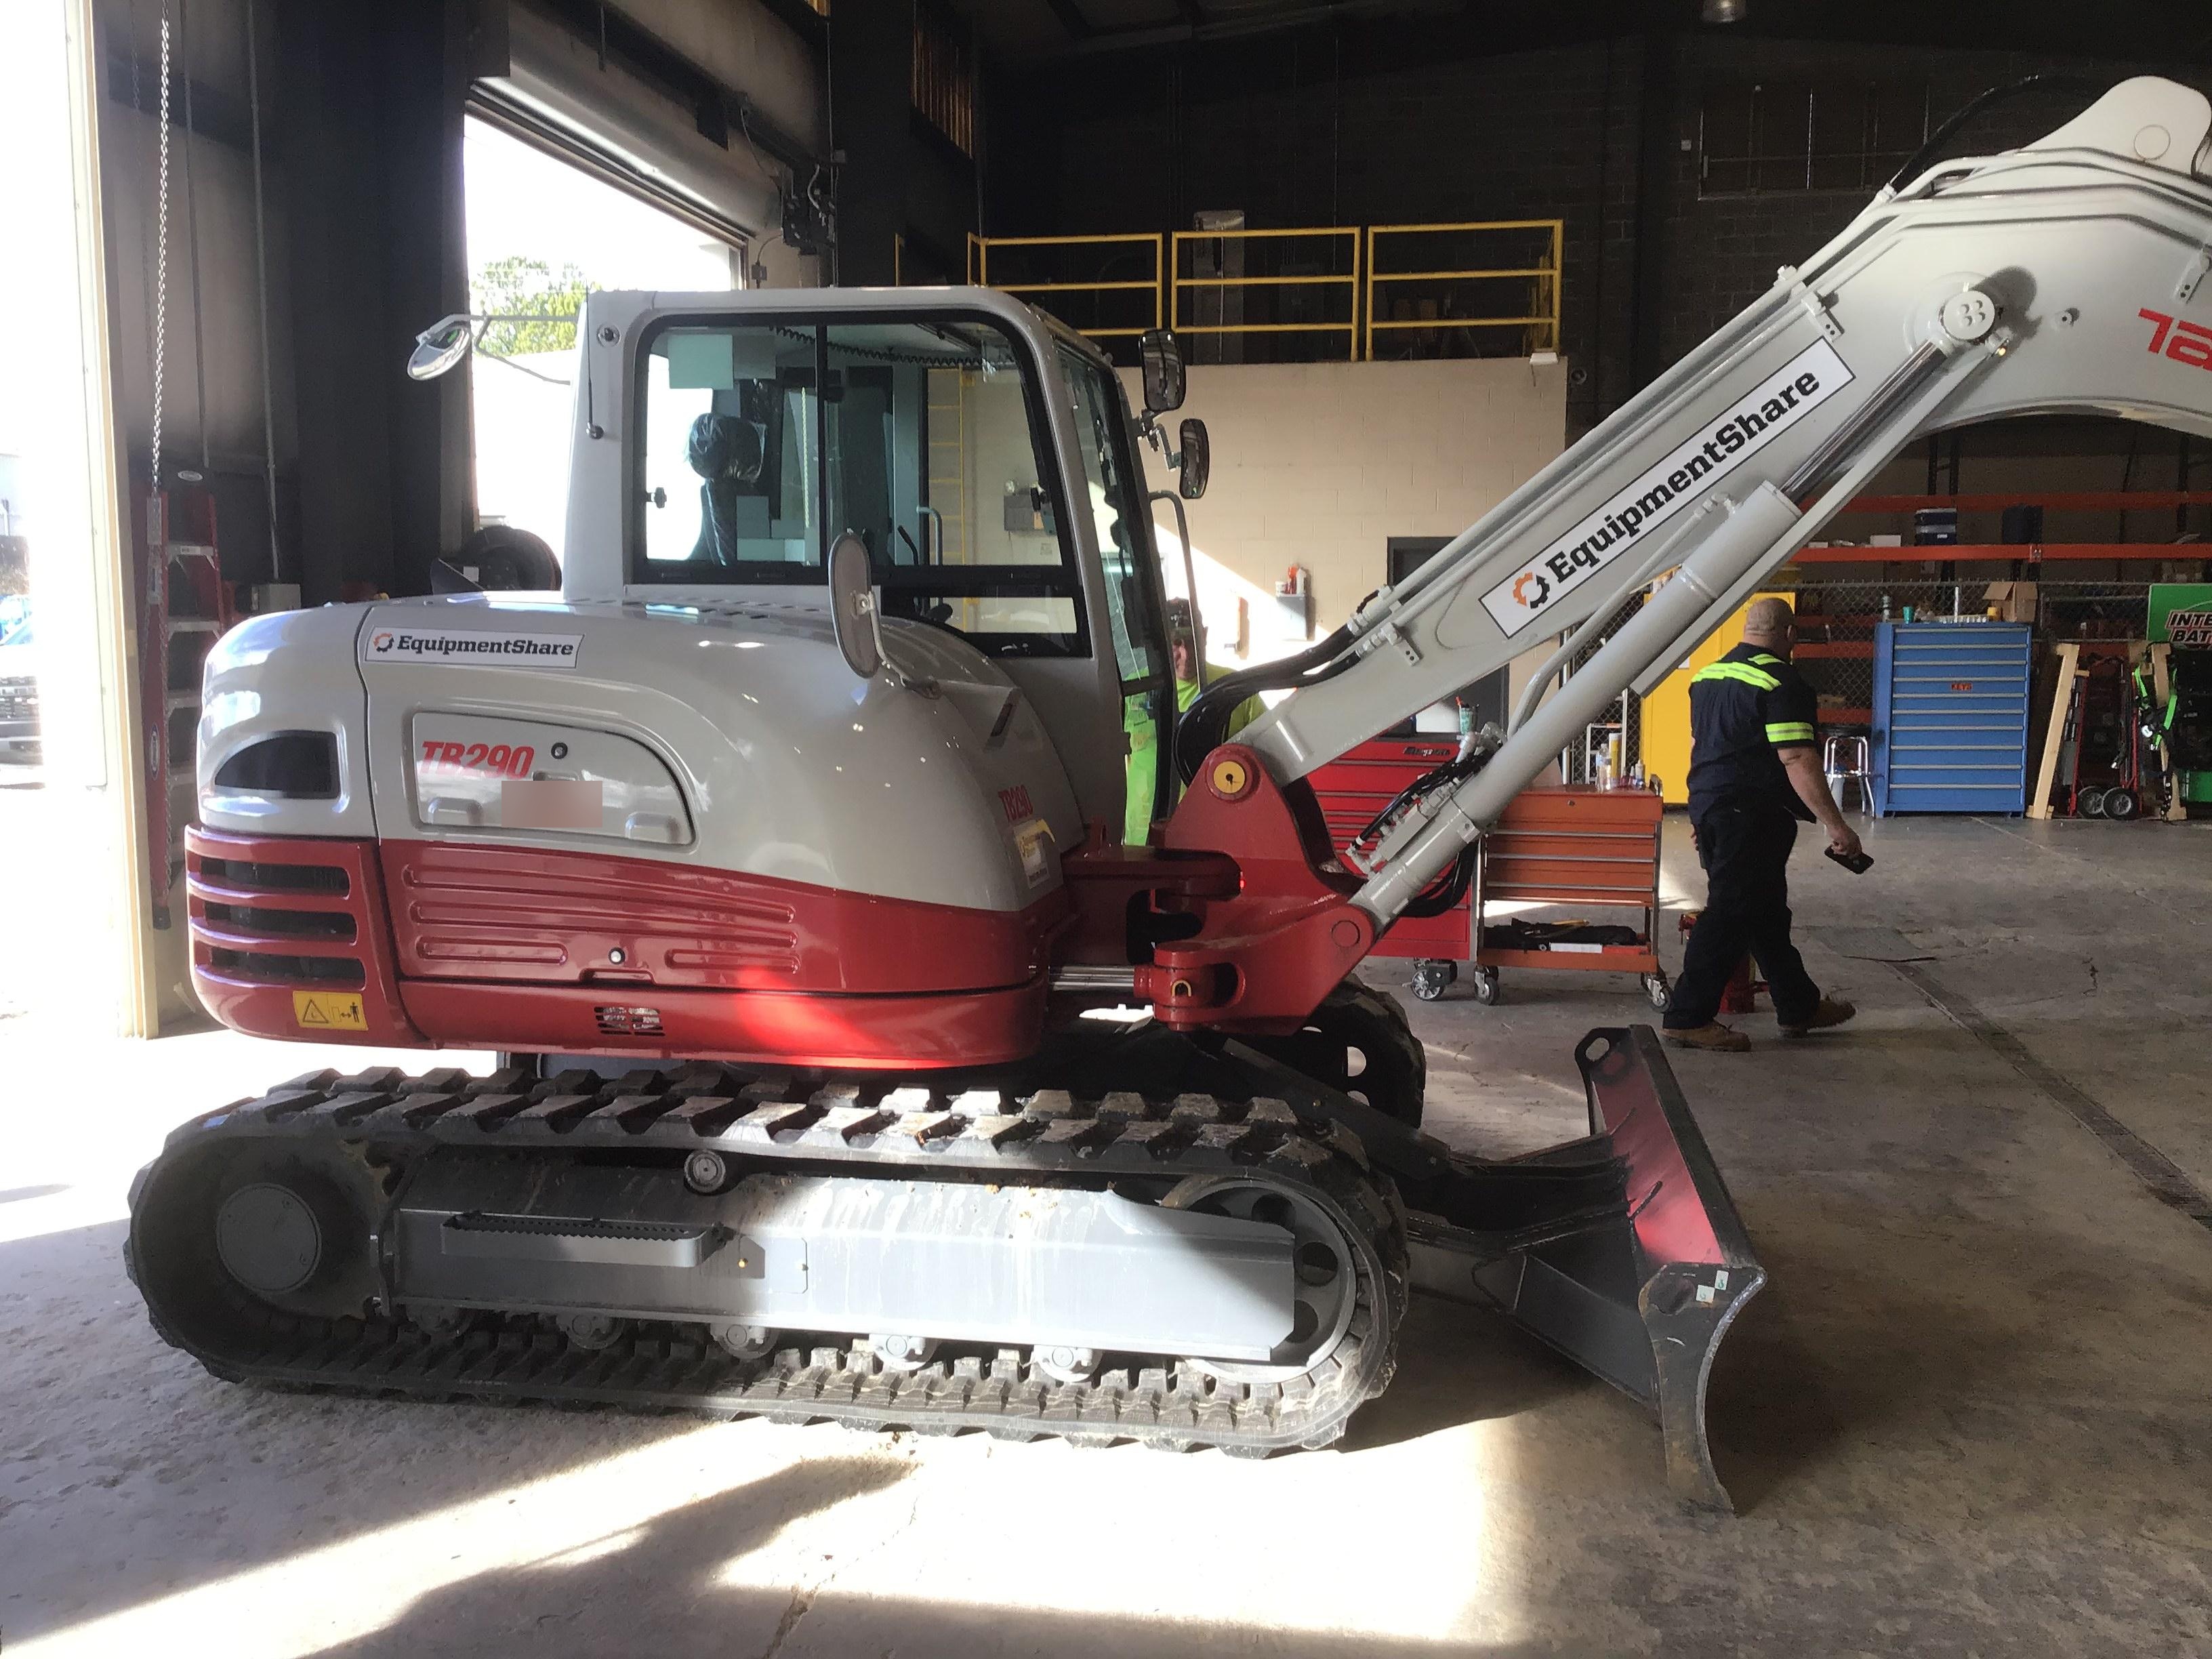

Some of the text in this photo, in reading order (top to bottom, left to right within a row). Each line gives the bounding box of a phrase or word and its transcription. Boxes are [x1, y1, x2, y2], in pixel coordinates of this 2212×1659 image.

[1545, 372, 1820, 583] EquipmentShare
[397, 635, 573, 655] EquipmentShare
[422, 741, 534, 779] TB290
